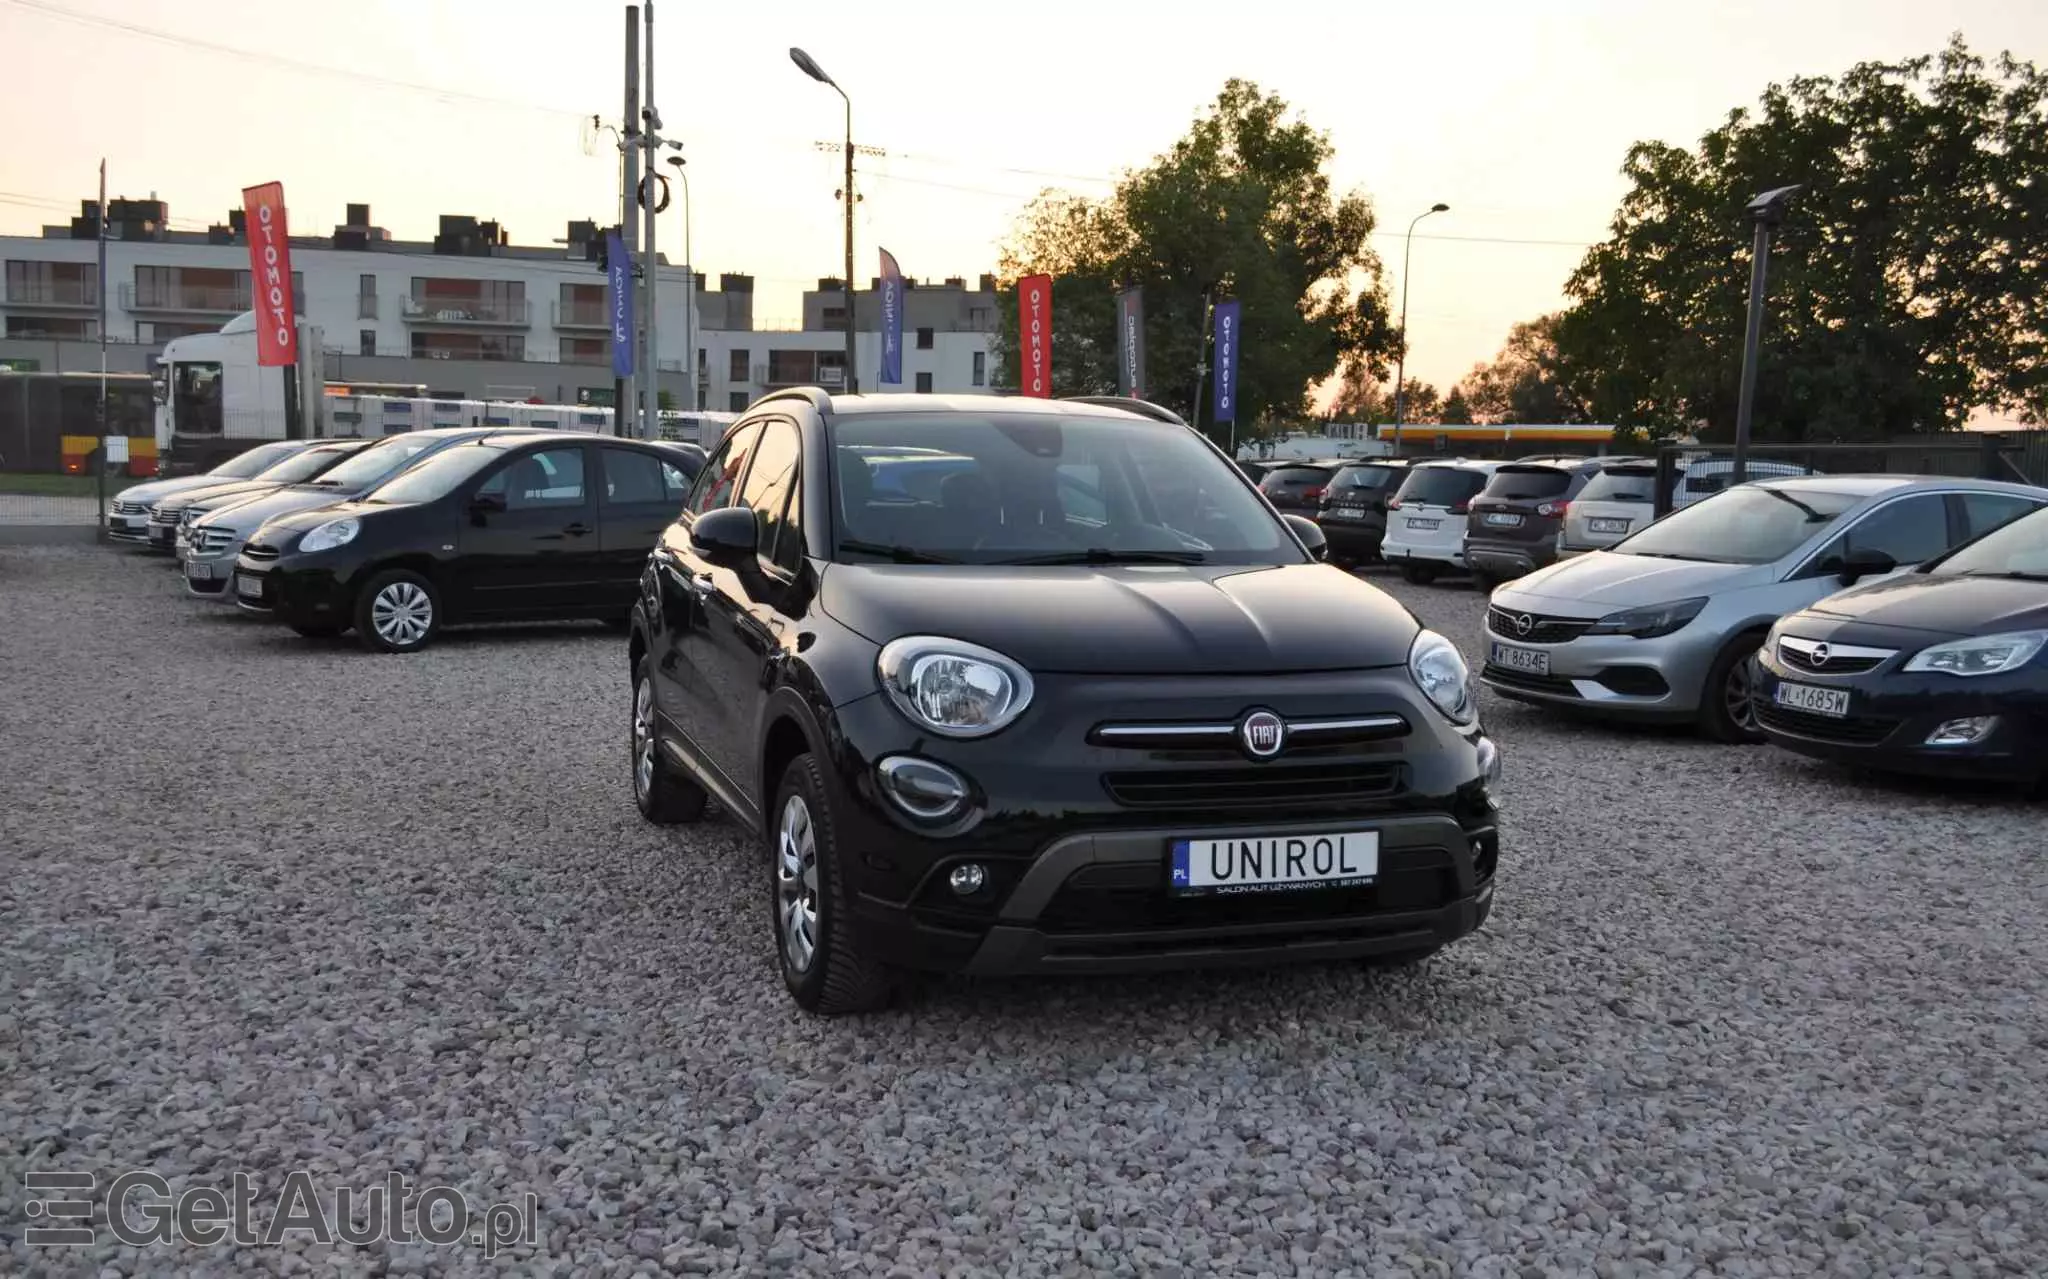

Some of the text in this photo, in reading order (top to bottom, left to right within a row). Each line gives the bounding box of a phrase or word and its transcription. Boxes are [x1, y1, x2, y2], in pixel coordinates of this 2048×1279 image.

[260, 205, 288, 346] OTOMOTO
[1031, 289, 1040, 392] OTOMOTO
[1221, 316, 1231, 409] OTOMOTO
[1512, 651, 1546, 670] 8634E
[1780, 684, 1847, 712] WL 1685W
[1253, 726, 1275, 744] FIAT
[1211, 837, 1357, 880] UNIROL
[1173, 869, 1187, 880] PL
[1216, 886, 1249, 894] SALON
[1249, 884, 1268, 892] AUT
